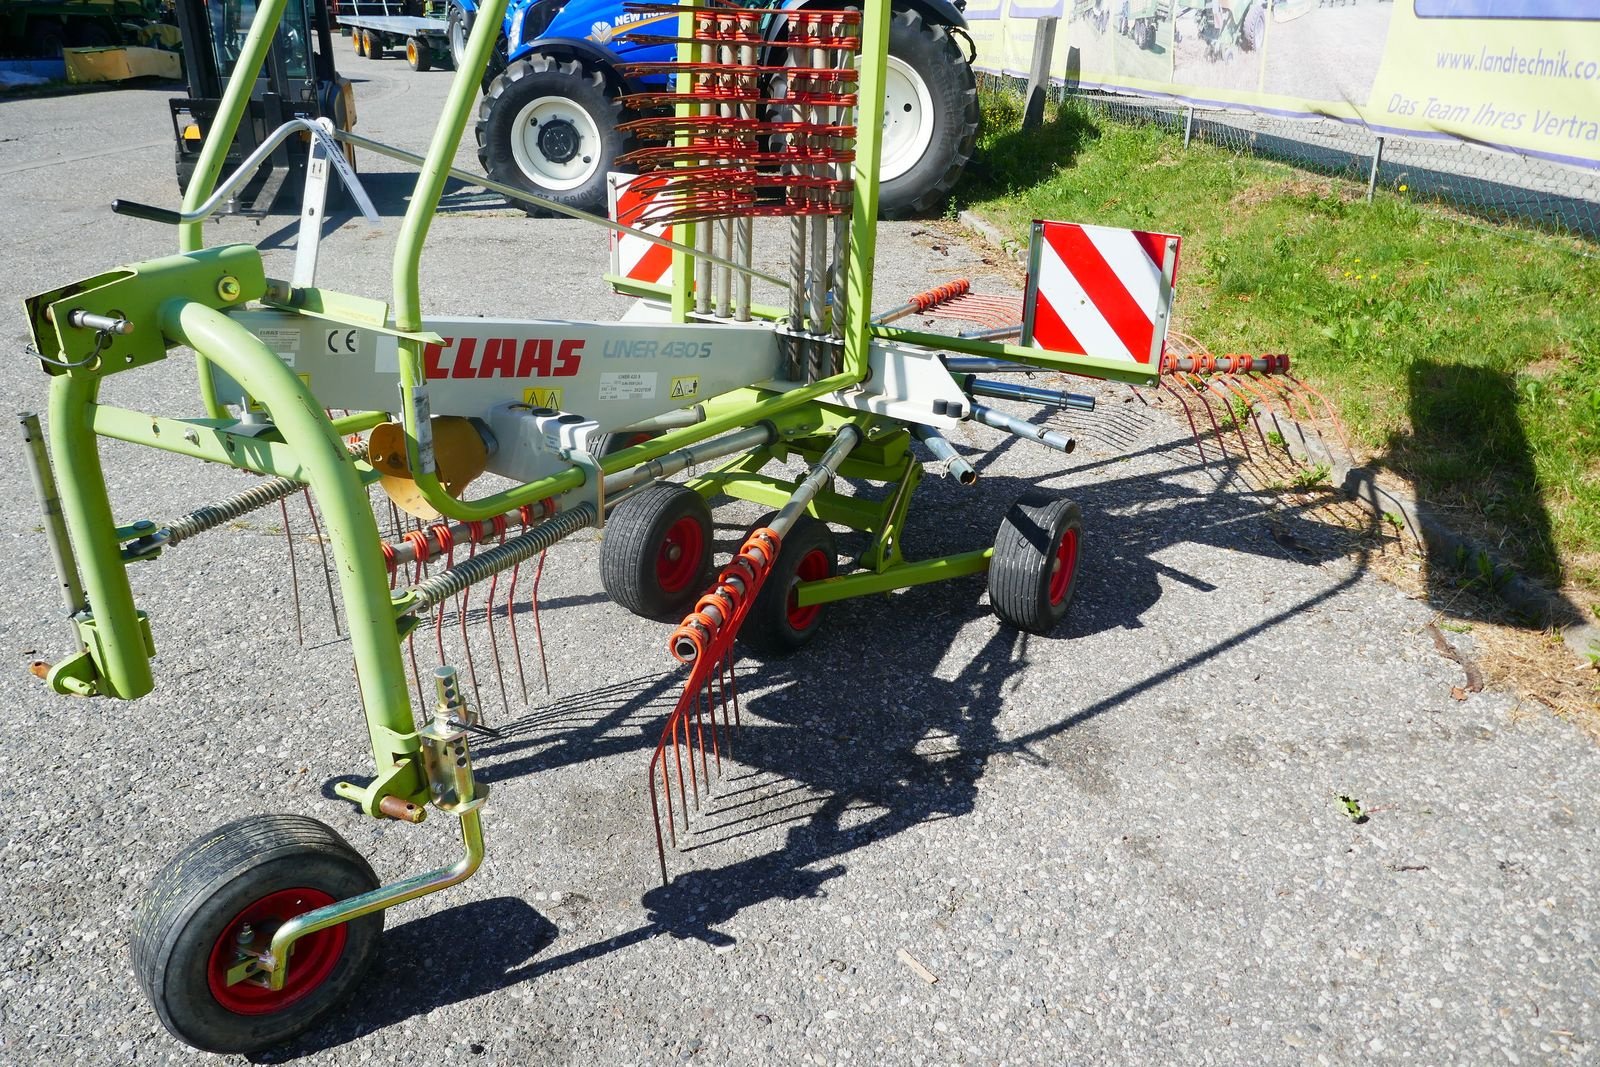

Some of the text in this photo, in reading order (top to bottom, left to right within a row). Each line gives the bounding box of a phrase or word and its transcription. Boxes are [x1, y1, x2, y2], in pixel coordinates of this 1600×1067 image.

[614, 13, 640, 27] NEW
[1387, 93, 1419, 116] Das
[1422, 97, 1470, 123] Team
[1472, 102, 1526, 130] Ihres
[424, 337, 586, 379] CLAAS
[603, 340, 658, 358] LINER
